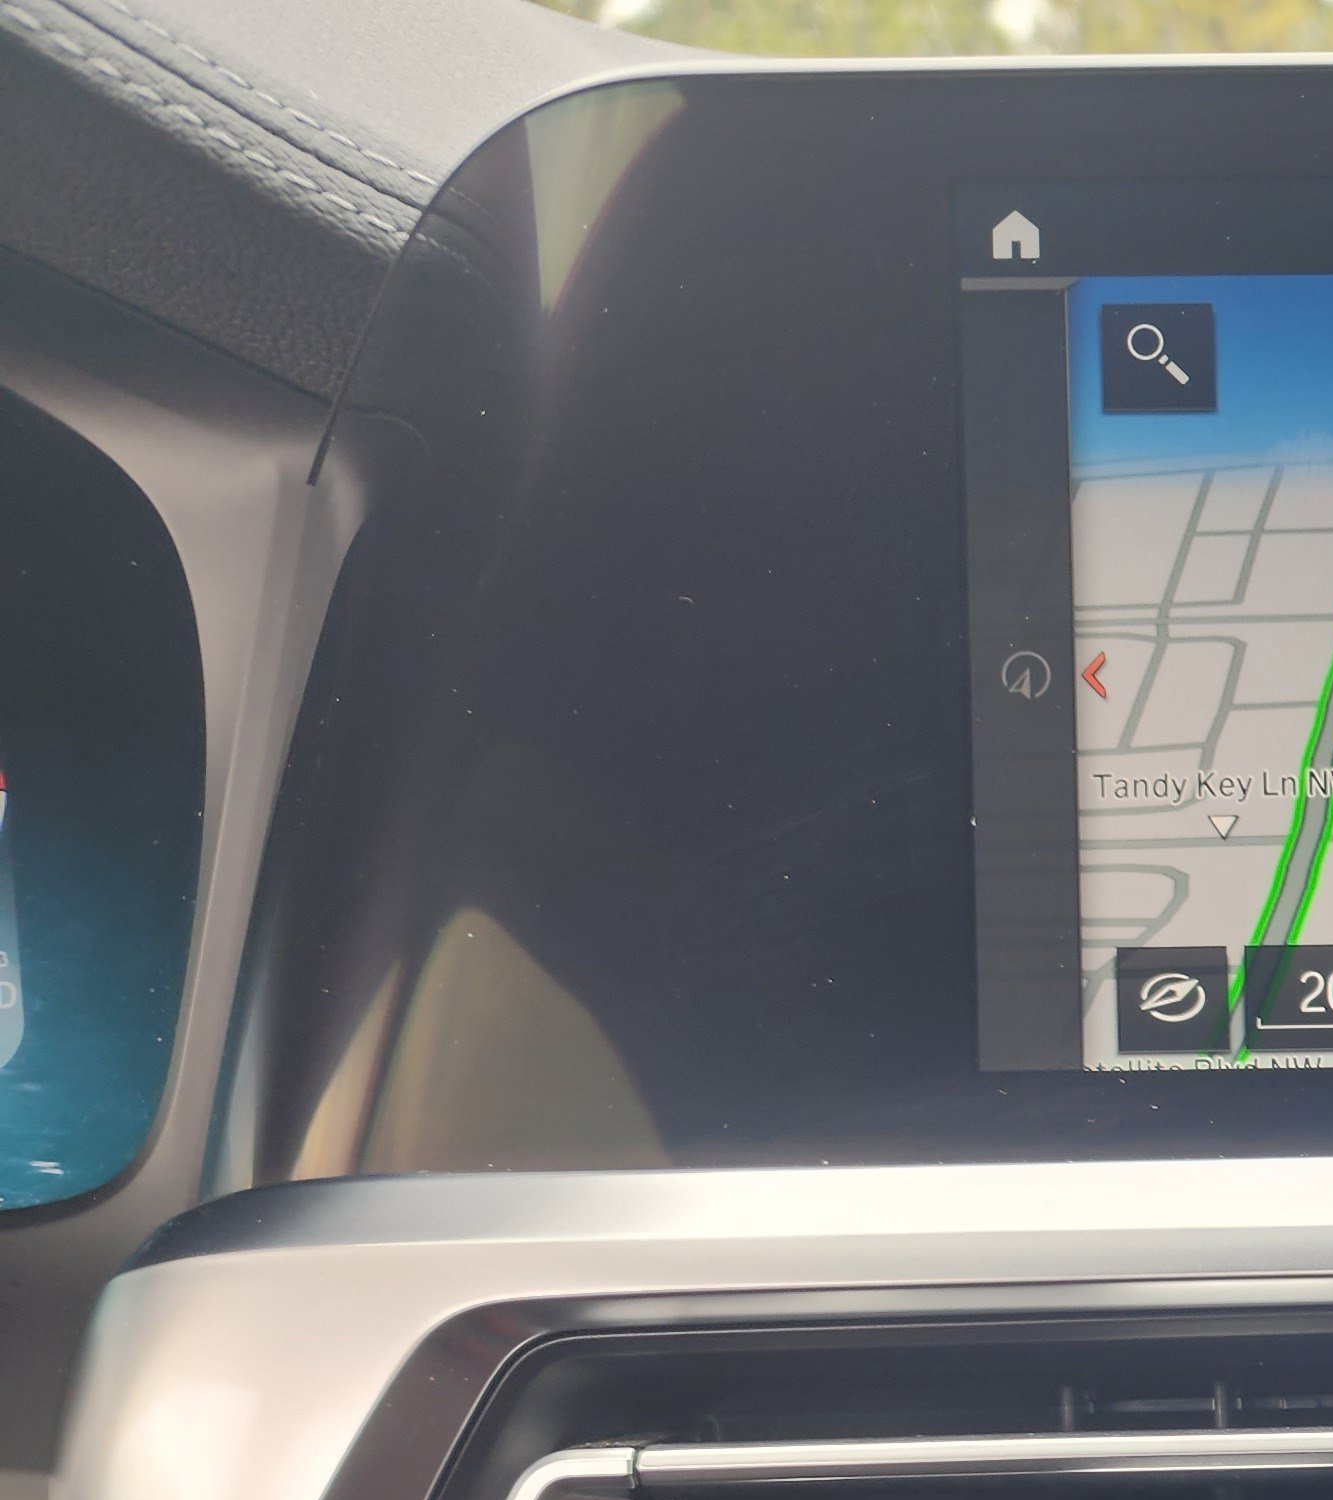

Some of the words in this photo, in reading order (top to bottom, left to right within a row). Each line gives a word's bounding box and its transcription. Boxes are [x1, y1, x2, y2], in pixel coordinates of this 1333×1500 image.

[1093, 773, 1188, 804] Tandy
[1197, 771, 1252, 802] Key
[1262, 770, 1297, 796] Ln
